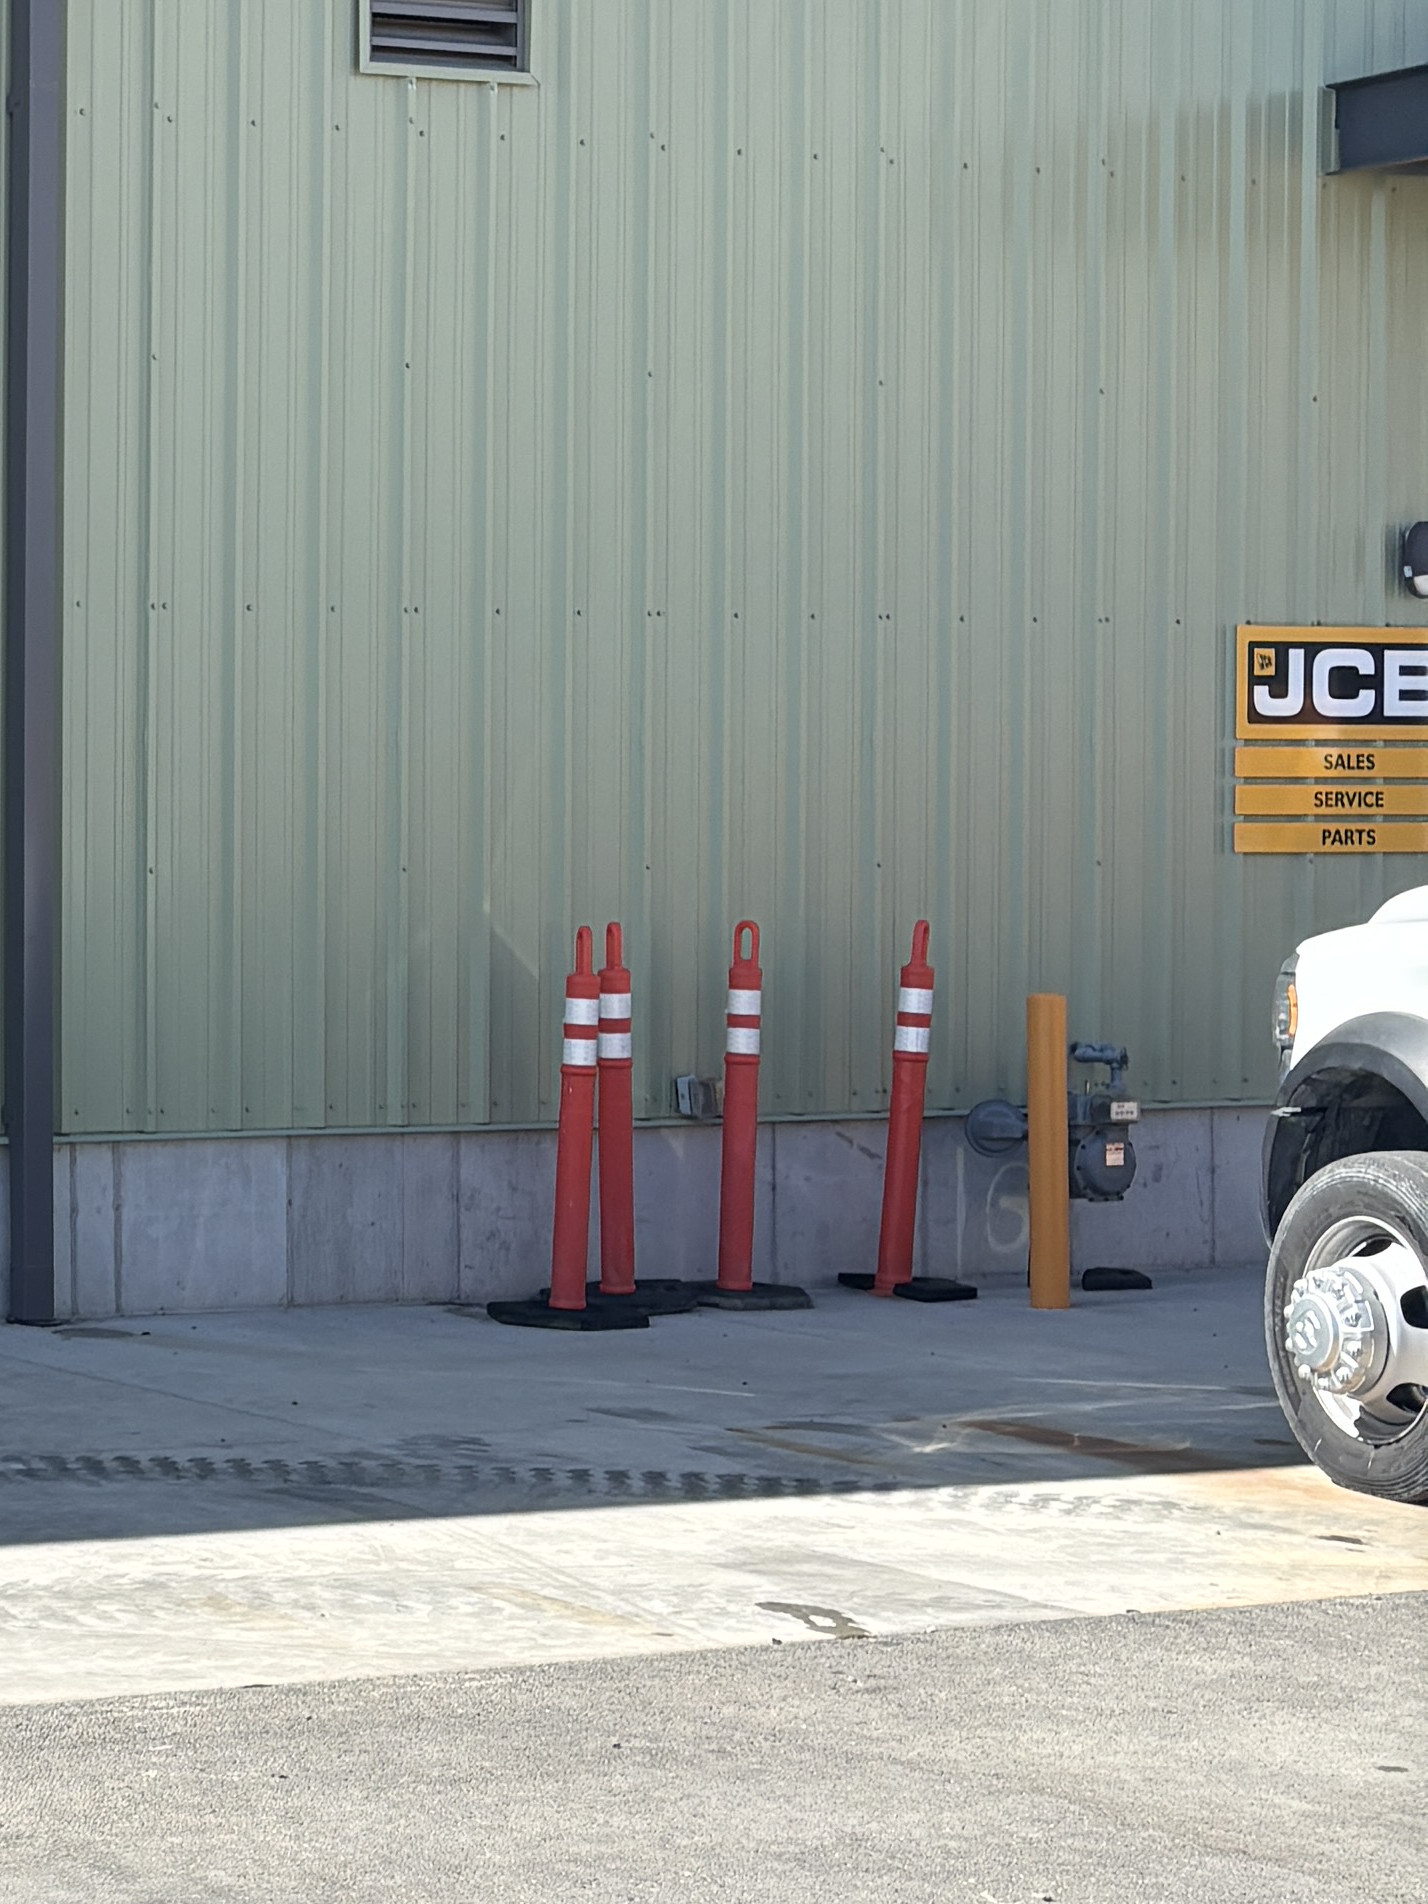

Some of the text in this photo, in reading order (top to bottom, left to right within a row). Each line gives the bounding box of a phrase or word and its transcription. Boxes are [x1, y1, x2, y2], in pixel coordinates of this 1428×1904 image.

[1253, 648, 1428, 717] JCB
[1323, 753, 1376, 771] SALES
[1313, 790, 1384, 809] SERVICE
[1321, 828, 1376, 846] PARTS
